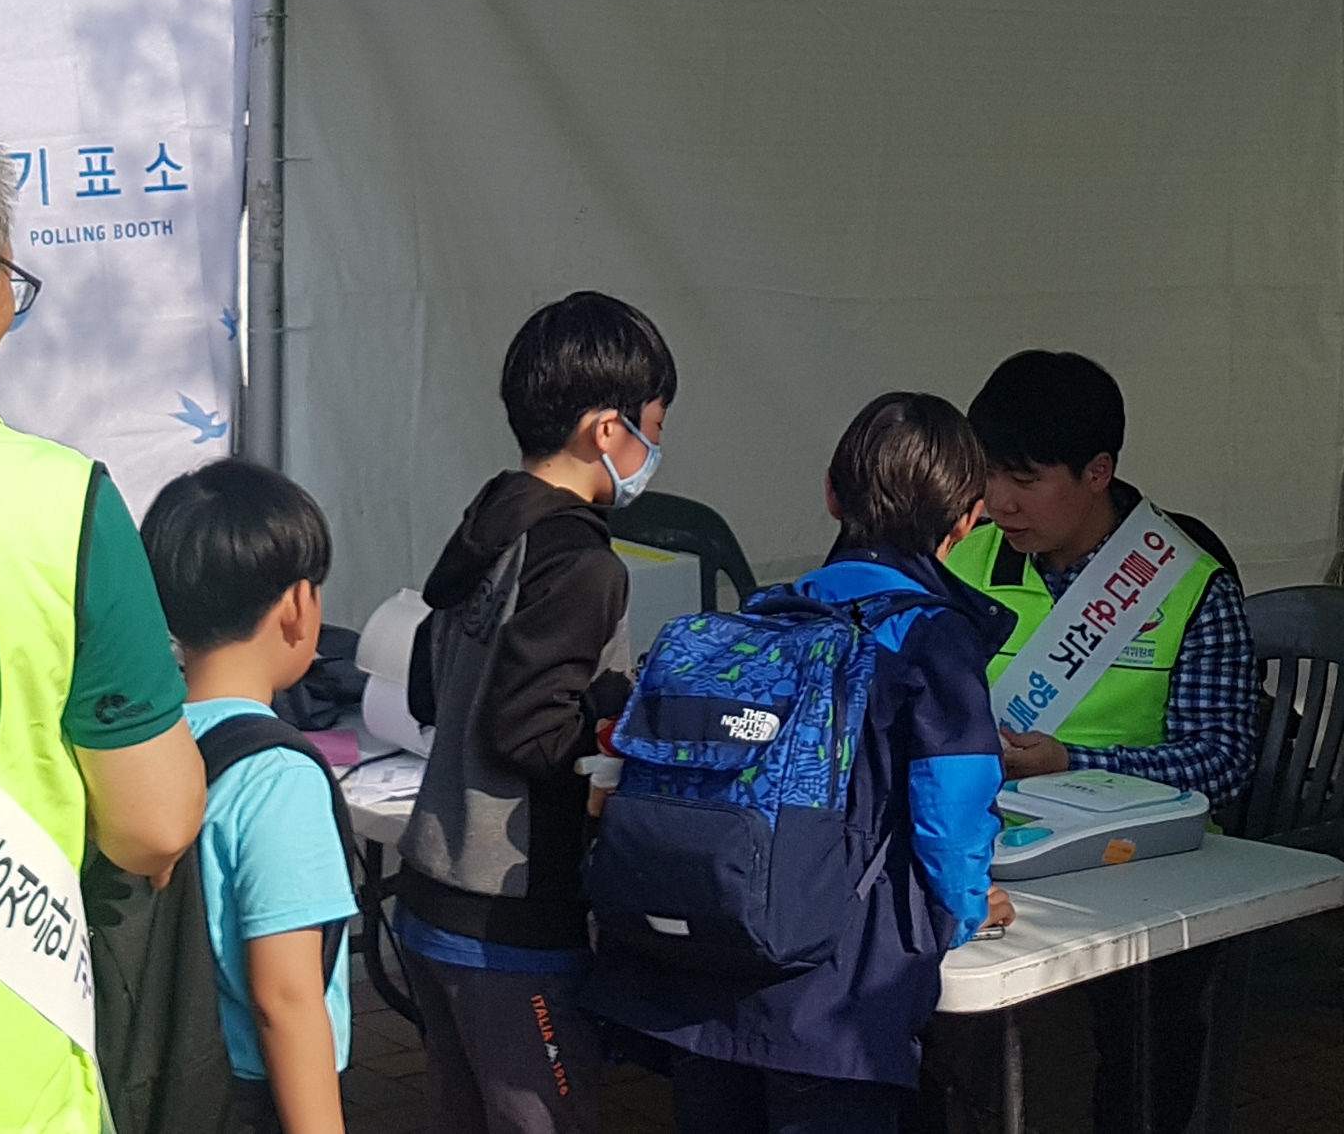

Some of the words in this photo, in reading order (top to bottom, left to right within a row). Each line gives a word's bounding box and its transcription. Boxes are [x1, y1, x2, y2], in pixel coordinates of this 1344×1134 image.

[30, 224, 106, 246] POLLING
[113, 219, 174, 240] BOOTH
[720, 714, 765, 733] NORTH
[742, 707, 768, 723] THE
[729, 726, 763, 741] FACE
